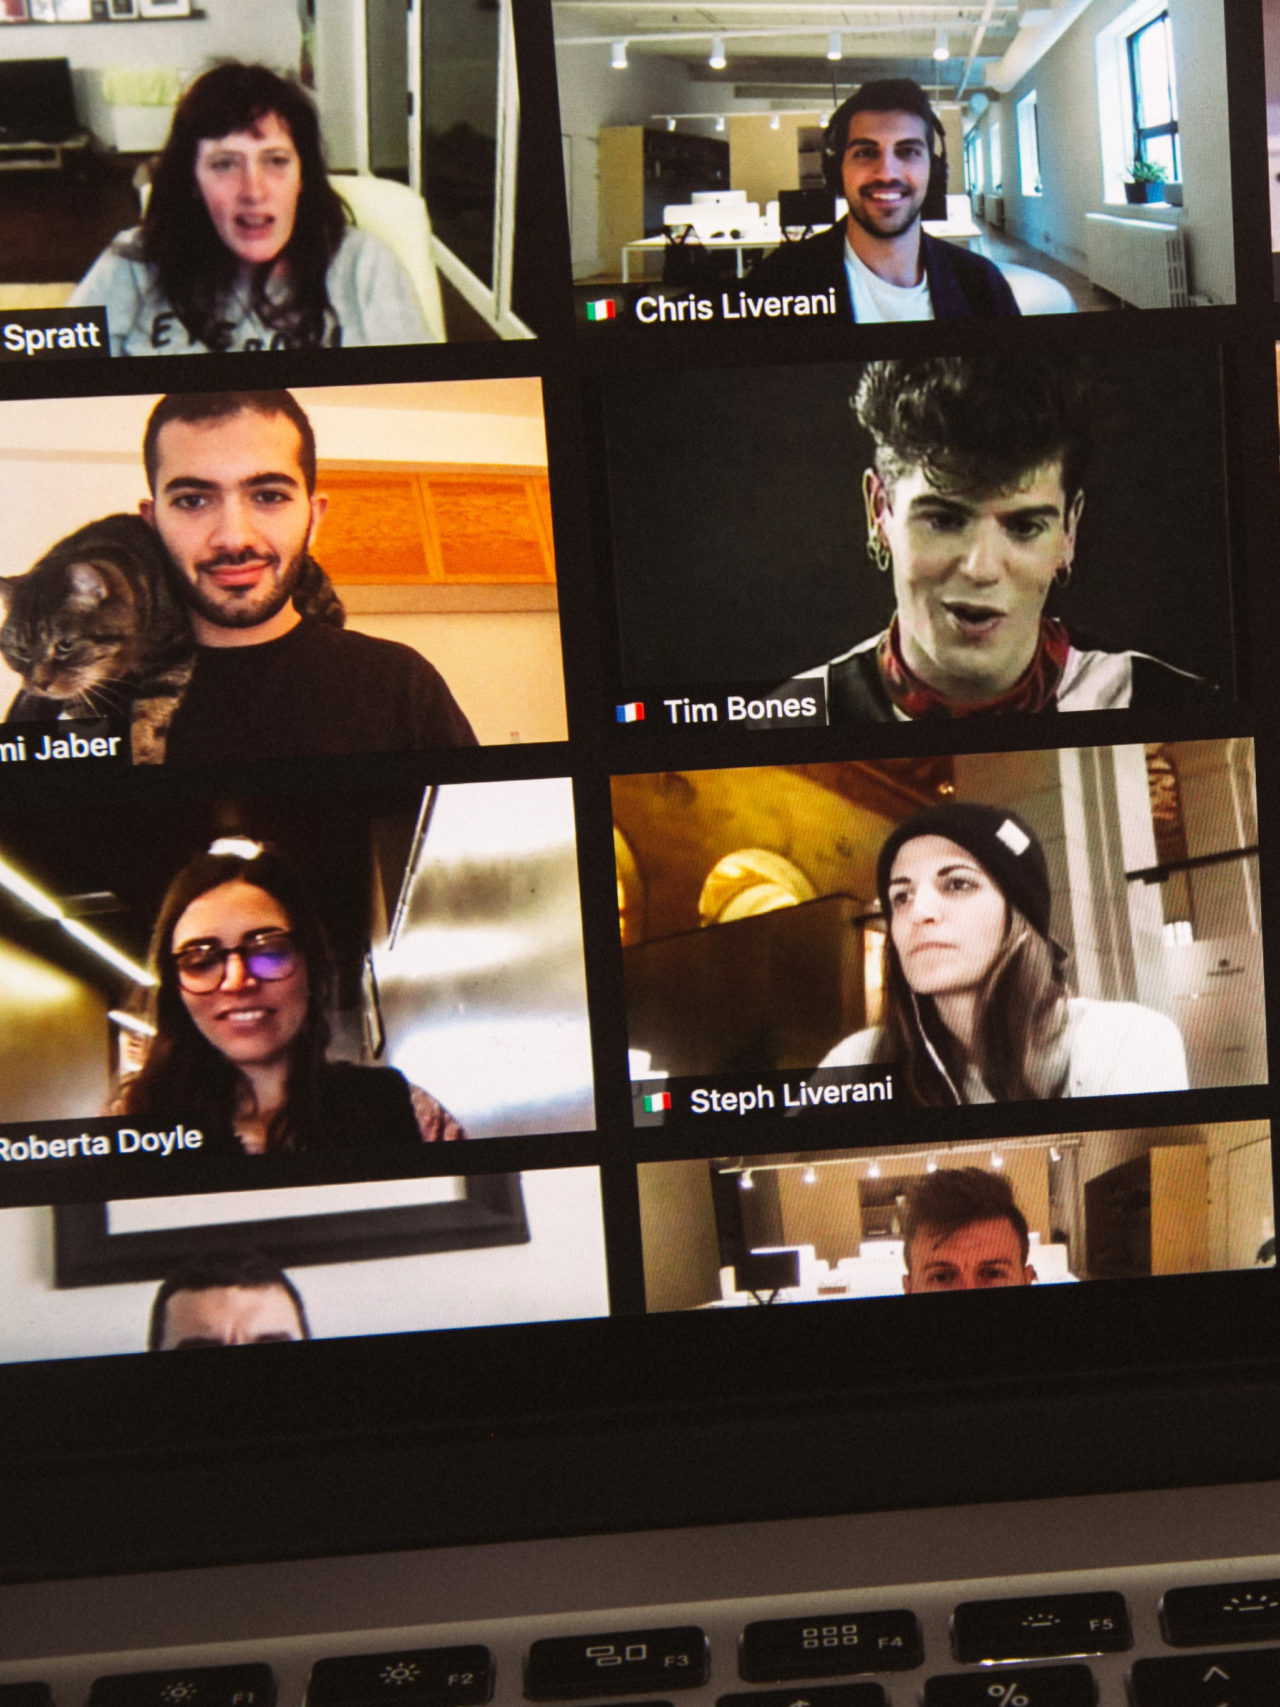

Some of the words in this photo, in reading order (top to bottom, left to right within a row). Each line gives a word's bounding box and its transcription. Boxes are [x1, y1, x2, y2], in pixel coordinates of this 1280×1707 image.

[635, 294, 713, 323] Chris
[721, 287, 836, 319] Liverani
[2, 322, 102, 356] Spratt
[663, 698, 718, 724] Tim
[727, 696, 817, 721] Bones
[33, 732, 122, 760] Jaber
[690, 1084, 774, 1115] Steph
[783, 1075, 892, 1107] Liverani
[116, 1124, 204, 1156] Doyle
[1089, 1618, 1114, 1632] F5
[878, 1636, 904, 1649] F4
[664, 1655, 689, 1668] F3
[447, 1673, 475, 1686] F2
[233, 1692, 255, 1705] F1
